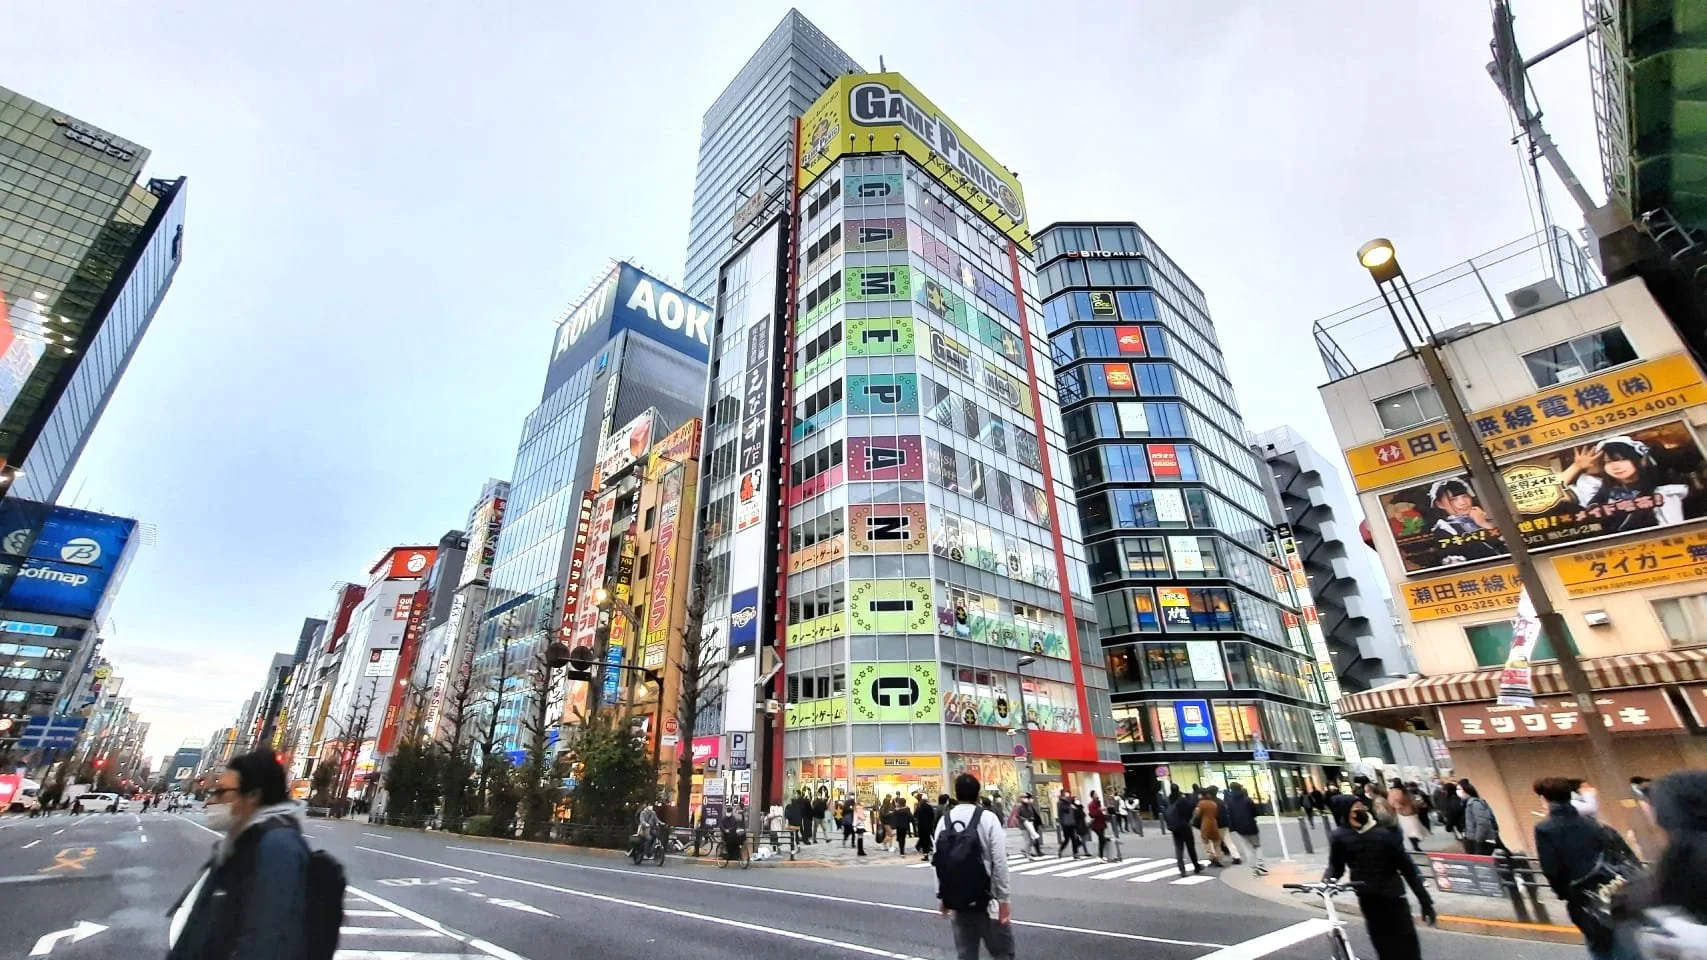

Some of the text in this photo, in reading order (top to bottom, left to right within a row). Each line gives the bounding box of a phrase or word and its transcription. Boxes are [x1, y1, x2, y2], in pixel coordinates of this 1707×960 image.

[853, 84, 937, 143] GAME
[938, 118, 1000, 200] PANIC
[1081, 250, 1112, 258] BITO
[627, 279, 710, 345] AOK
[1542, 429, 1566, 440] TEL
[1569, 393, 1688, 432] 03-3253-4001
[651, 524, 674, 628] ラムタラ
[1435, 607, 1451, 615] TEL
[733, 734, 744, 748] P
